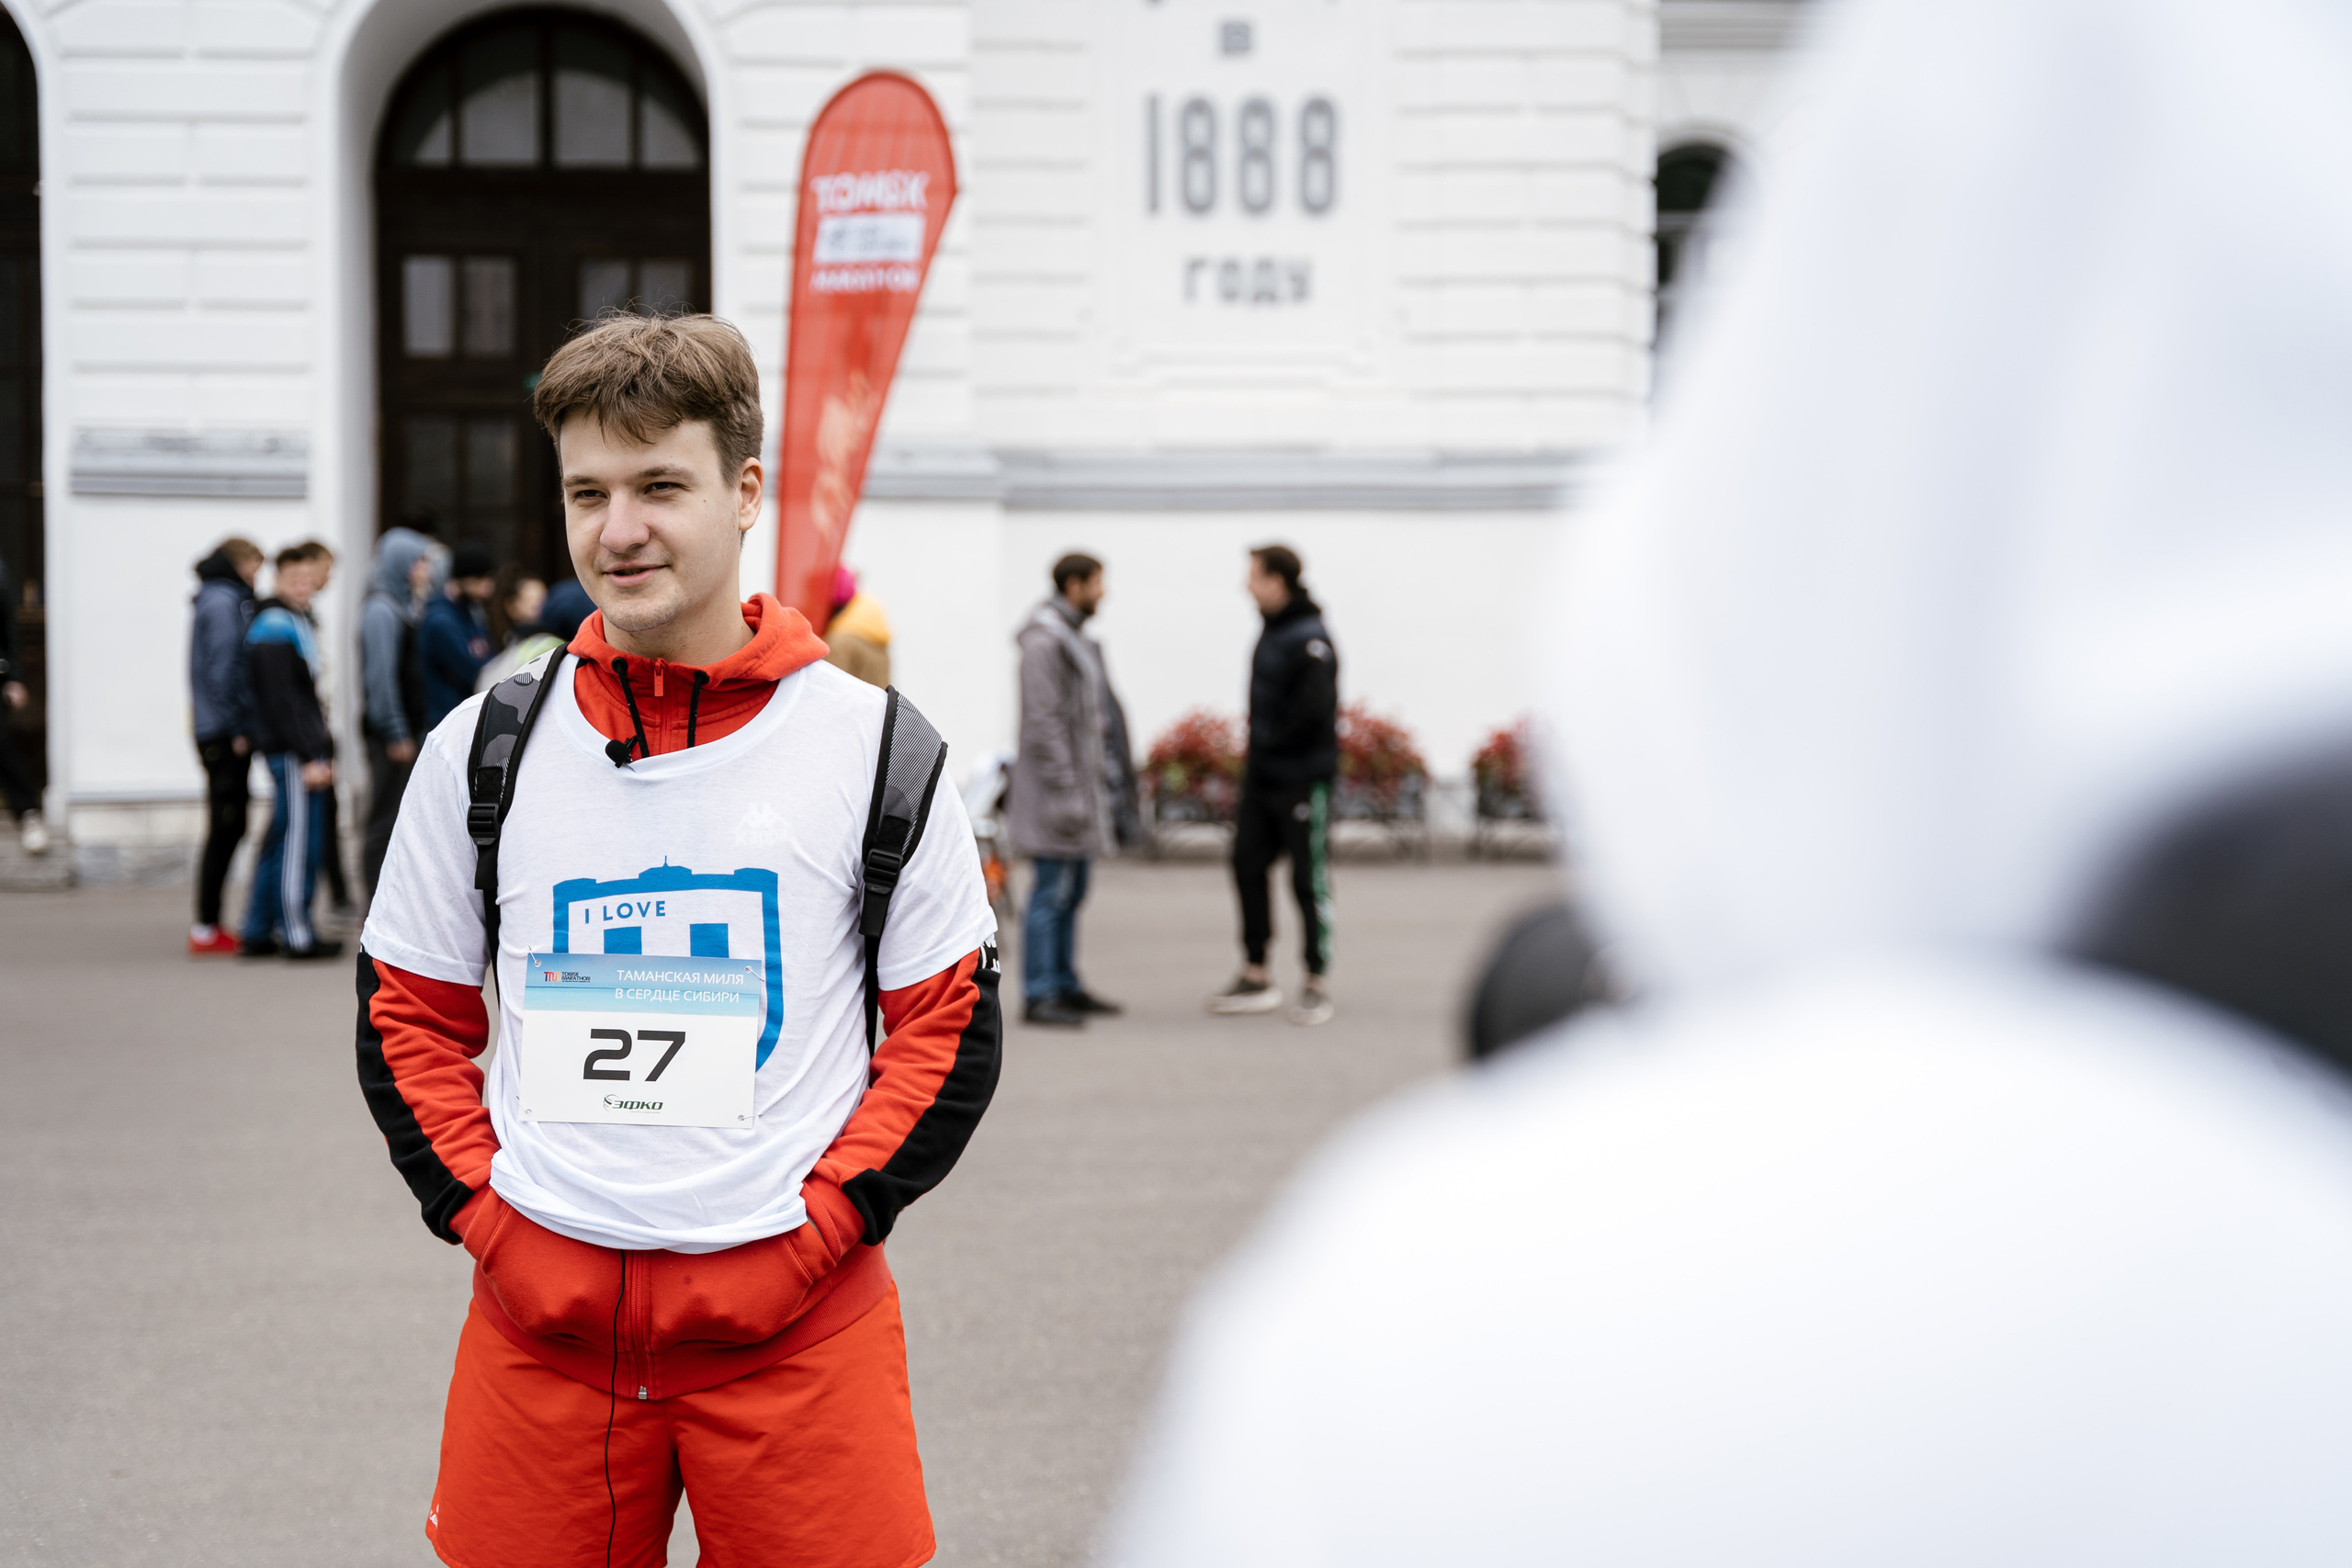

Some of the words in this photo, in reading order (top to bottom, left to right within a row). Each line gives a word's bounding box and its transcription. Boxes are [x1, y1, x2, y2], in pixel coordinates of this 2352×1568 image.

[1146, 96, 1337, 217] 1888
[584, 908, 590, 924] I
[603, 900, 666, 921] LOVE
[616, 969, 700, 984] ТАМАНСКАЯ
[703, 973, 744, 986] МИЛЯ
[615, 987, 623, 999] В
[627, 988, 681, 1003] СЕРДЦЕ
[684, 990, 740, 1003] СИБИРИ
[582, 1028, 686, 1082] 27
[612, 1100, 663, 1111] ЭФКО
